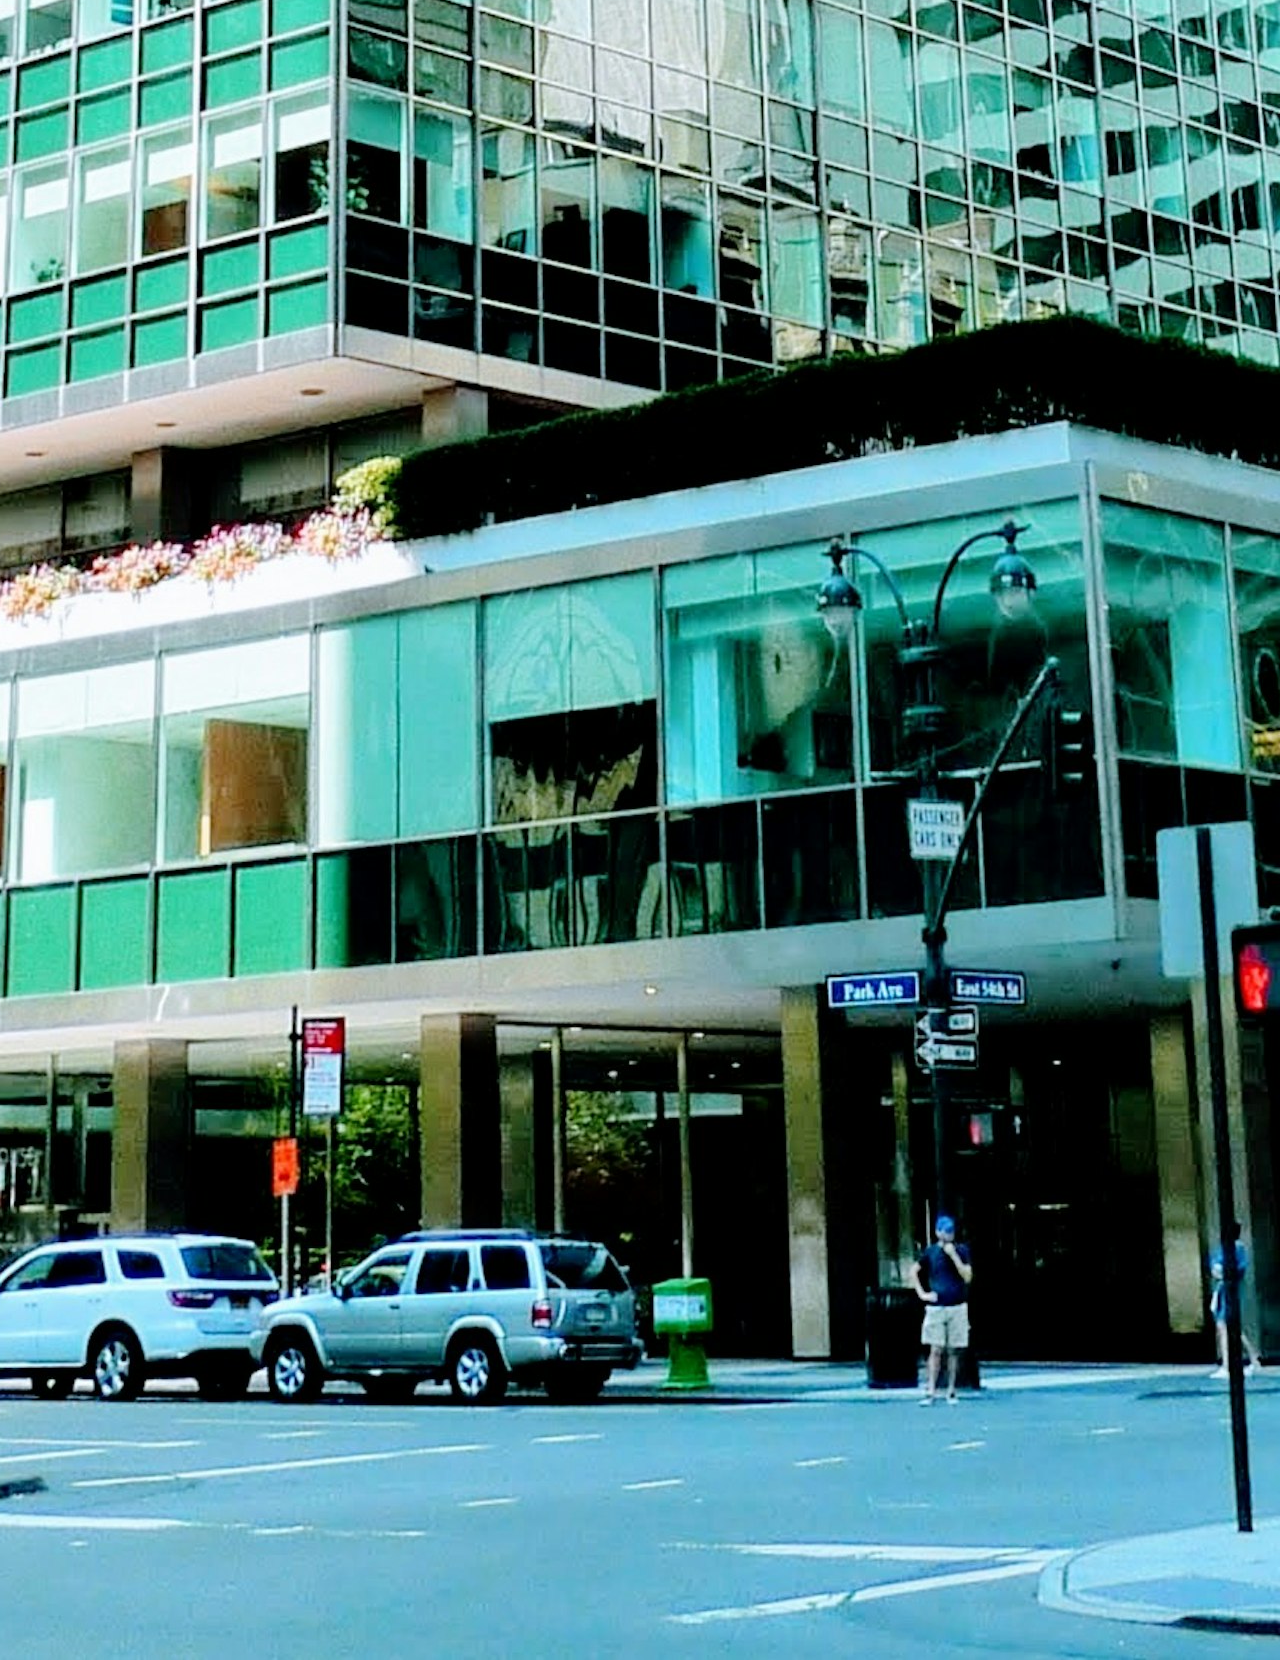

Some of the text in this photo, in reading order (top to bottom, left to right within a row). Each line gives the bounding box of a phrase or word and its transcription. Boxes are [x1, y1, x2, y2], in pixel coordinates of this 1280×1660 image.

[913, 808, 960, 826] PASSENGER
[915, 830, 936, 847] CARS
[843, 980, 903, 1001] Park Ave
[956, 978, 980, 996] East
[1006, 981, 1019, 998] St
